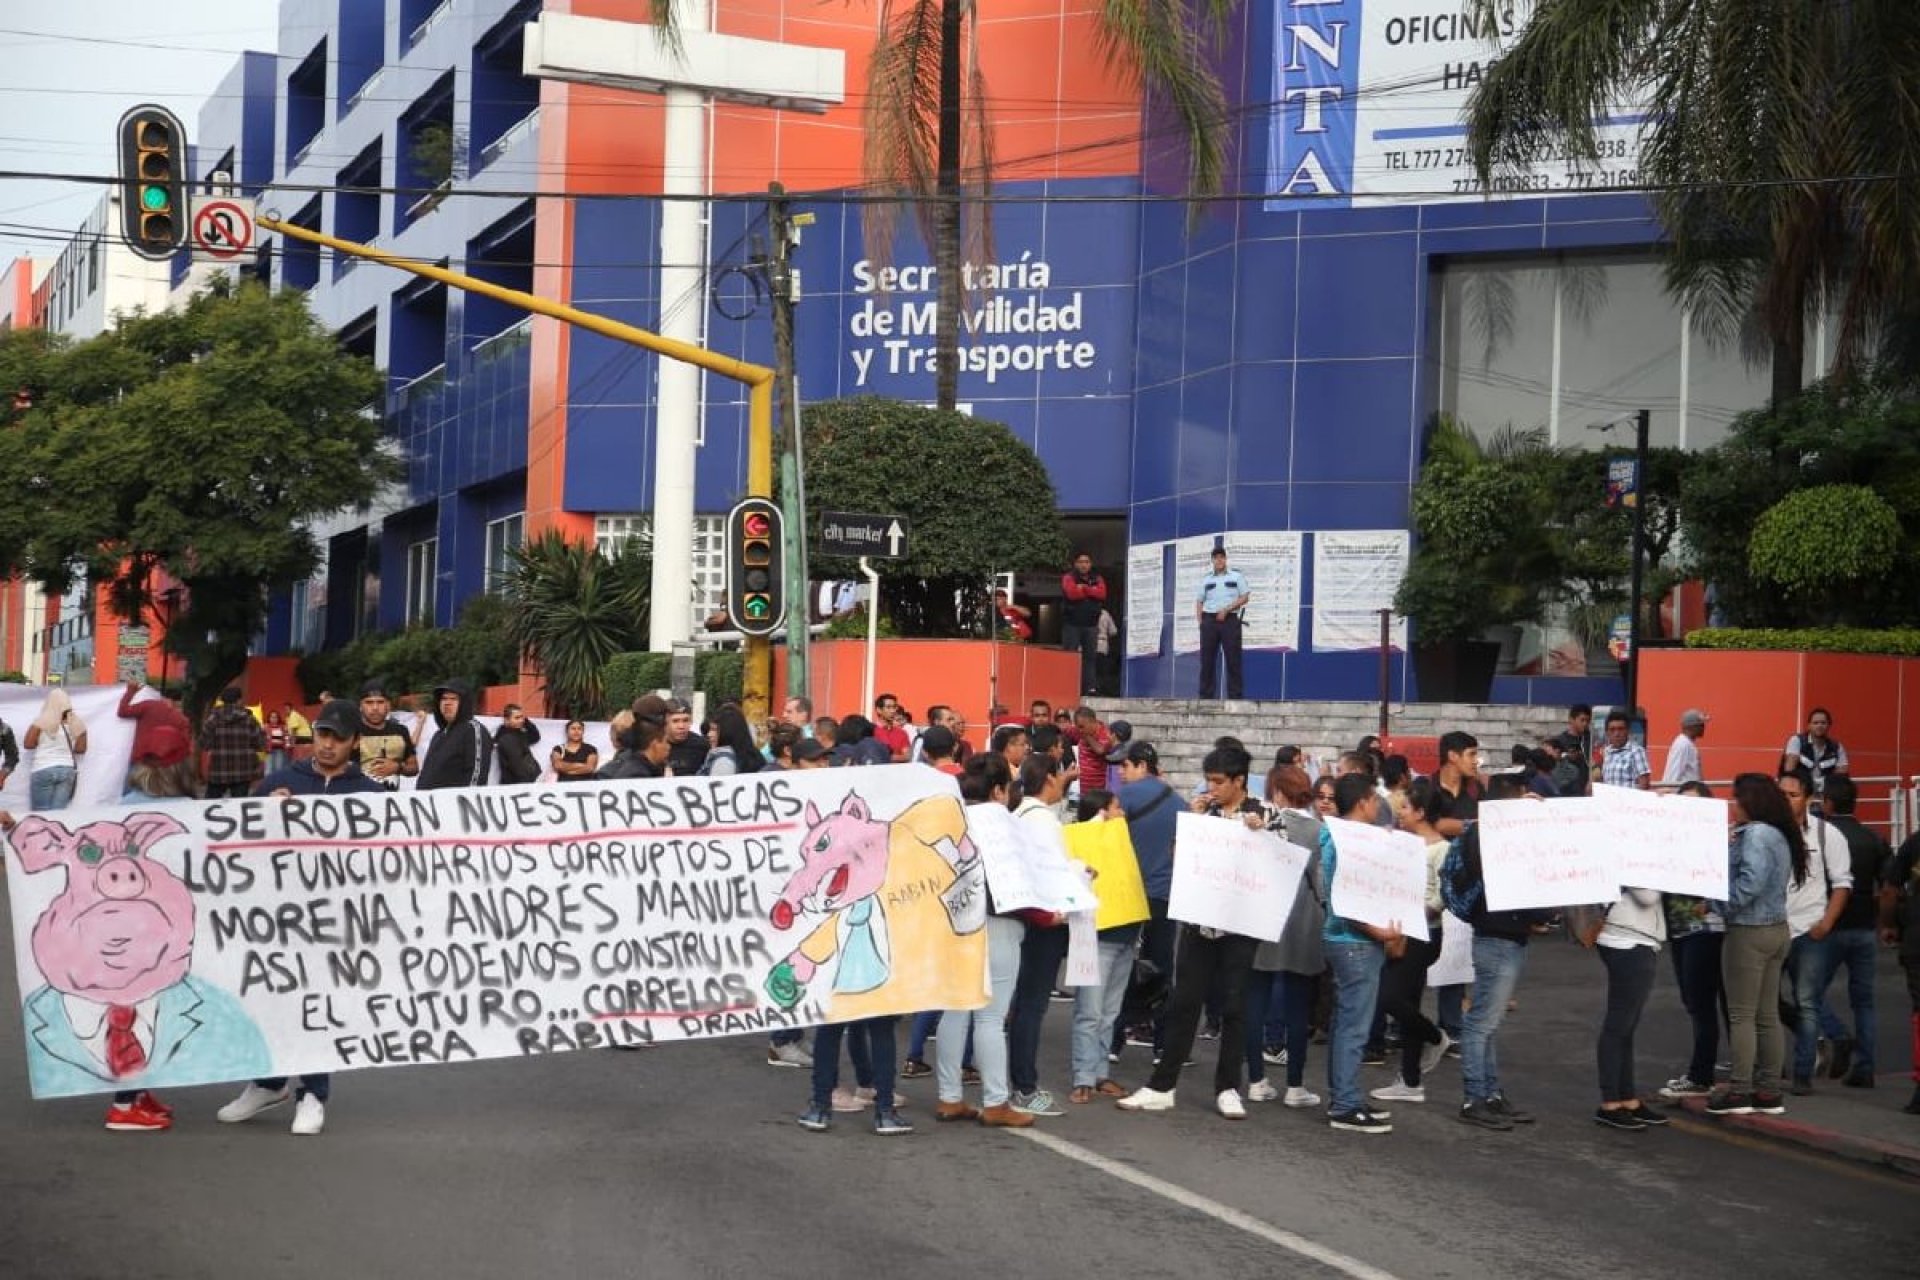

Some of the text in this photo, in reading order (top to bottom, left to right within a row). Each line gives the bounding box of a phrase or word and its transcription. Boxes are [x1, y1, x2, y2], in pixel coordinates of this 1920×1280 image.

[1385, 10, 1514, 45] OFICINAS
[1384, 151, 1408, 169] TEL
[1414, 150, 1441, 168] 777
[1453, 178, 1480, 192] 777
[1565, 172, 1594, 190] 777
[853, 250, 1049, 292] Secrtaría
[851, 292, 1082, 336] de Mvilidad
[852, 348, 873, 386] y
[823, 523, 883, 542] city market
[204, 779, 802, 840] SE ROBAN NUESTRAS BECAS
[184, 834, 791, 894] LOS FUNCIONARIOS CORRUPTOS DE
[636, 874, 769, 925] MANUEL
[239, 927, 775, 997] ASI NO PODEMOS CONSTRUIR
[303, 994, 344, 1032] EL
[336, 1029, 477, 1064] FUERA
[516, 1016, 654, 1057] RABIN
